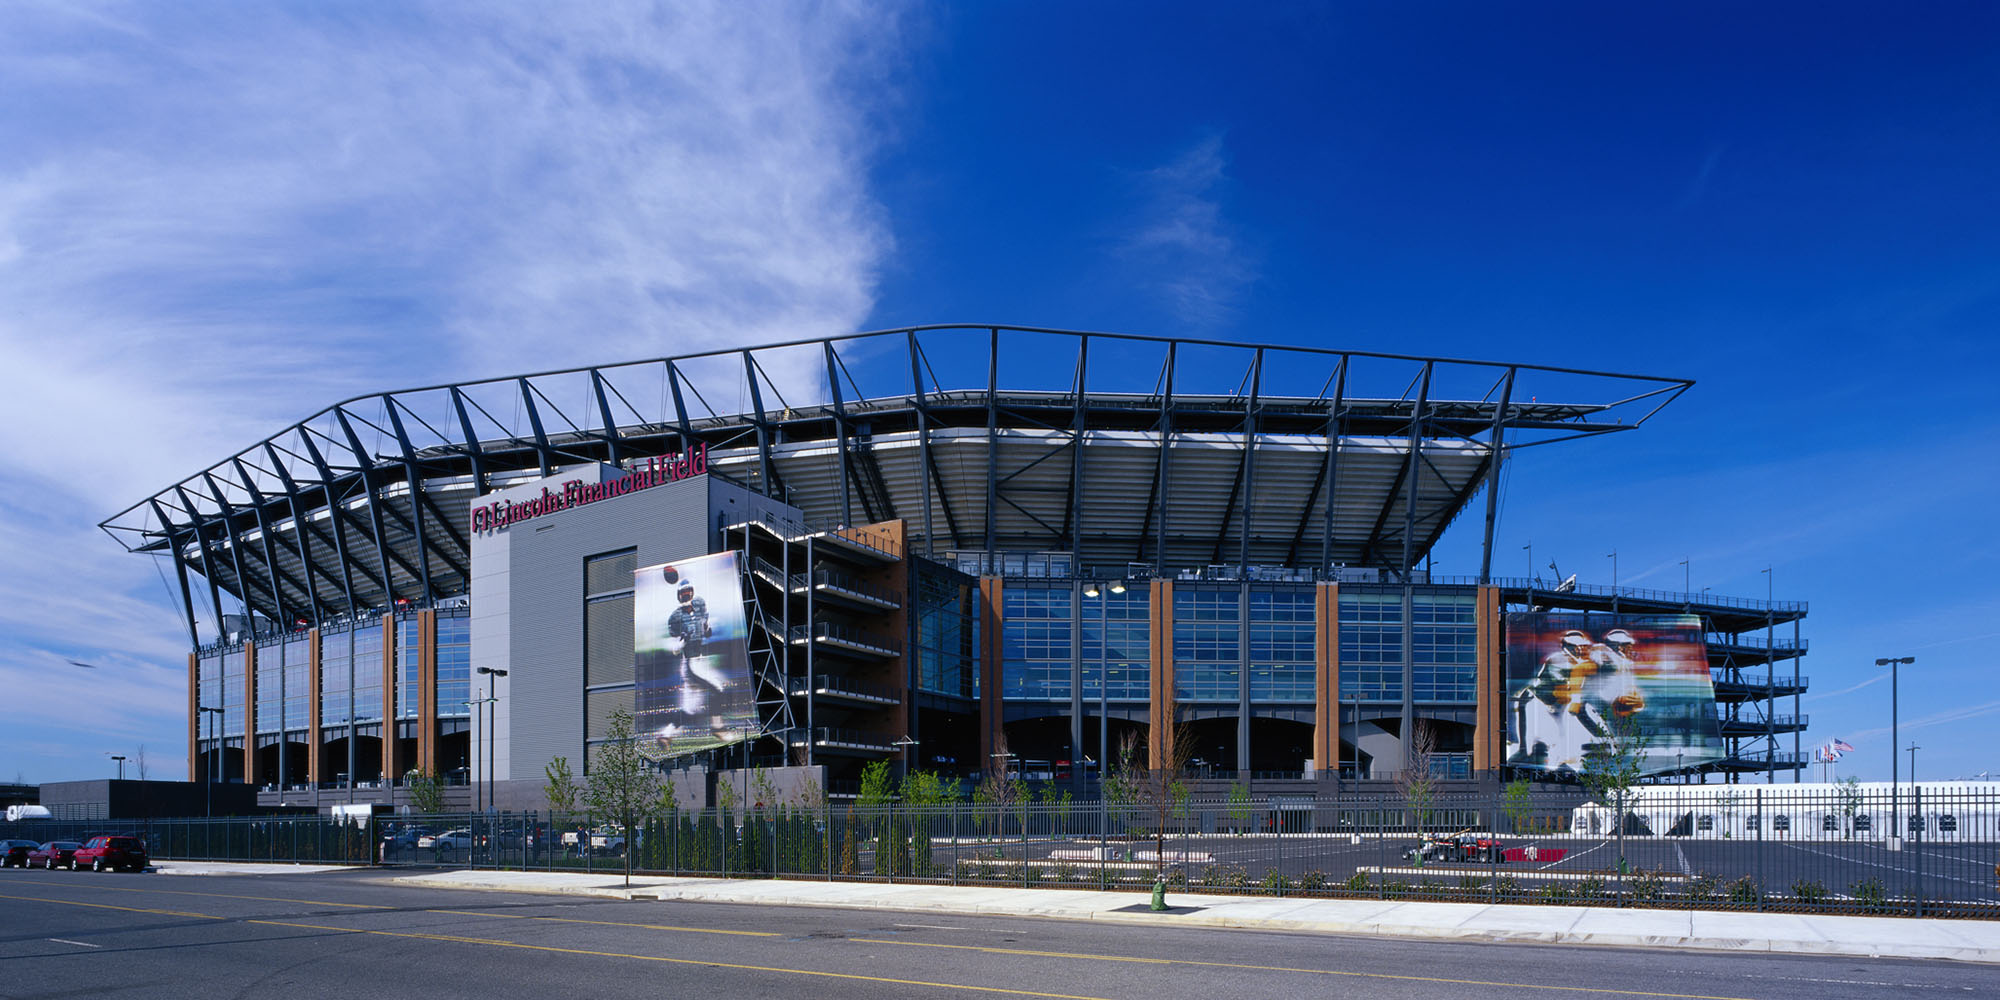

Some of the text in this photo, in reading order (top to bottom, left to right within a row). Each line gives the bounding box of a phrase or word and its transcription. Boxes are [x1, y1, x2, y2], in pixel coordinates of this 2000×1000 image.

[490, 442, 708, 528] Lincoln Financial Field
